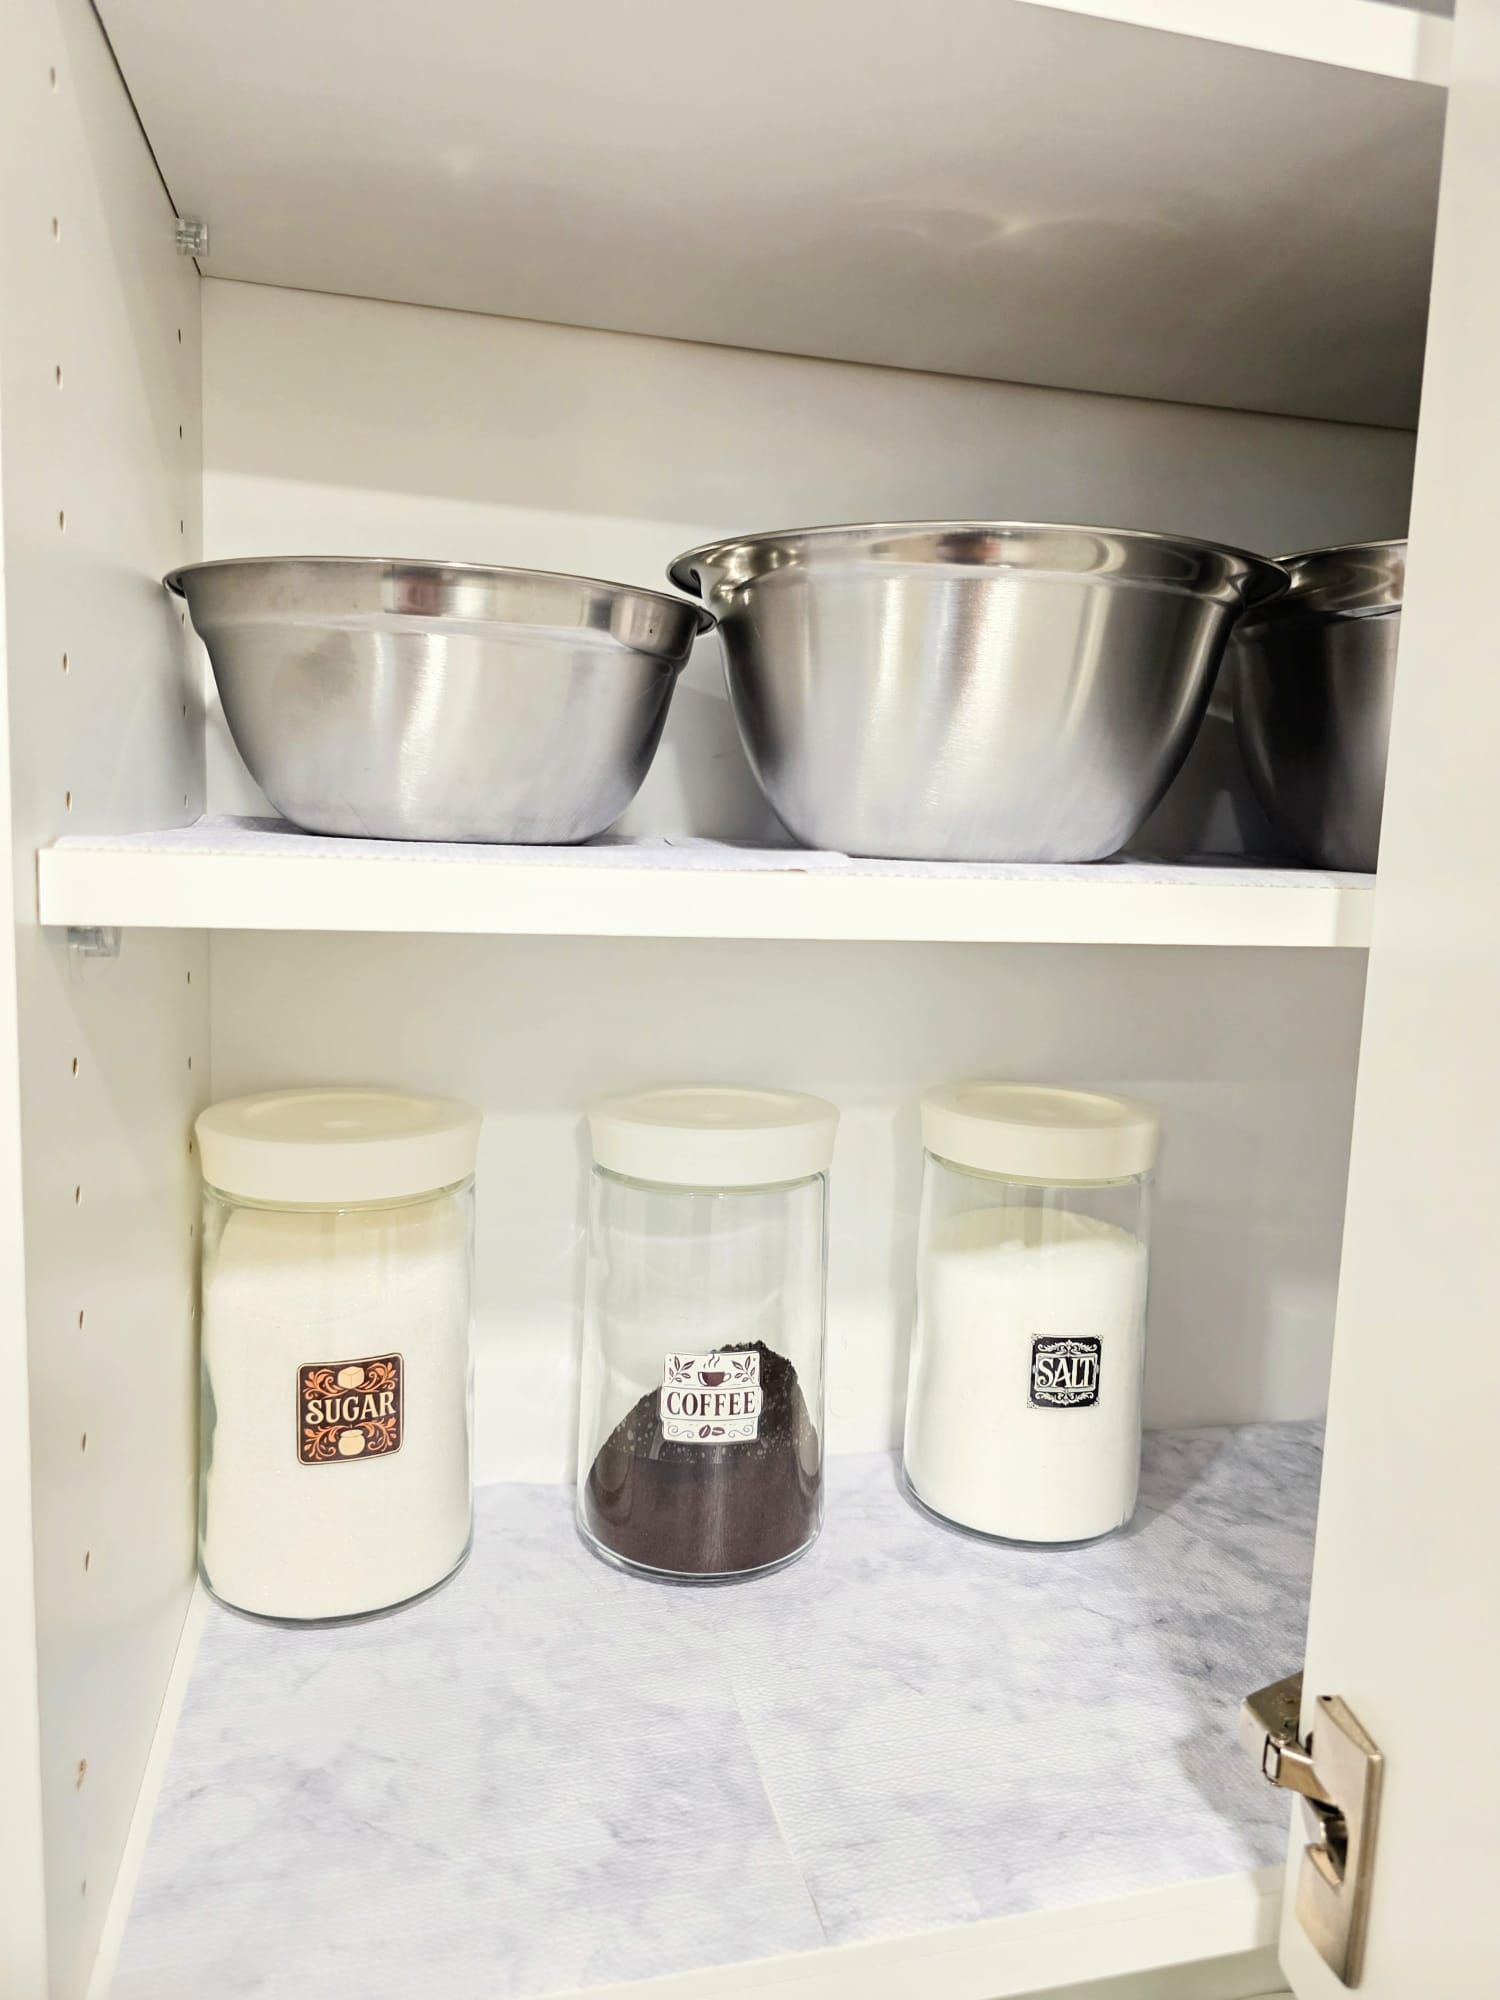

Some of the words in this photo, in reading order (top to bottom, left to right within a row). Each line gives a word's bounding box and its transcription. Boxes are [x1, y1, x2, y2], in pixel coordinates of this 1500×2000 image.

[1037, 1357, 1095, 1388] SALT
[305, 1391, 397, 1425] SUGAR
[666, 1391, 756, 1417] COFFEE
